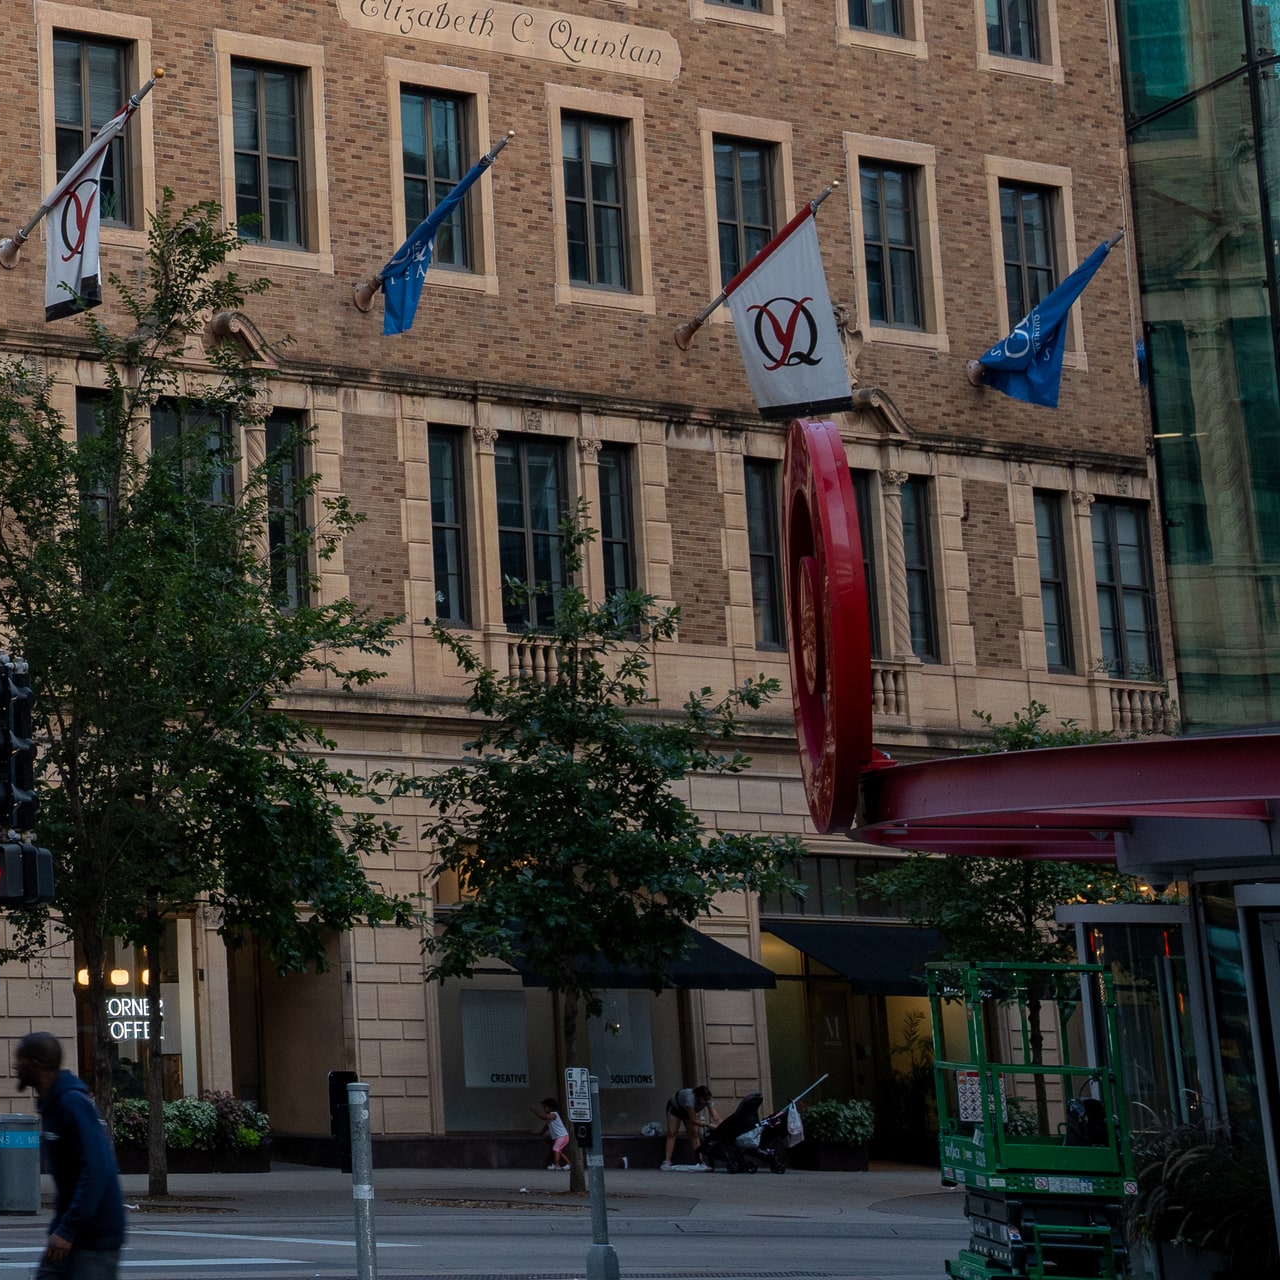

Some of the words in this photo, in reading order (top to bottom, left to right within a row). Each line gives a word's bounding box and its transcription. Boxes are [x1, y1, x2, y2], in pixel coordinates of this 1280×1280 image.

[548, 19, 663, 66] Quinlan
[490, 1073, 527, 1084] CREATIVE
[610, 1074, 653, 1084] SOLUTIONS
